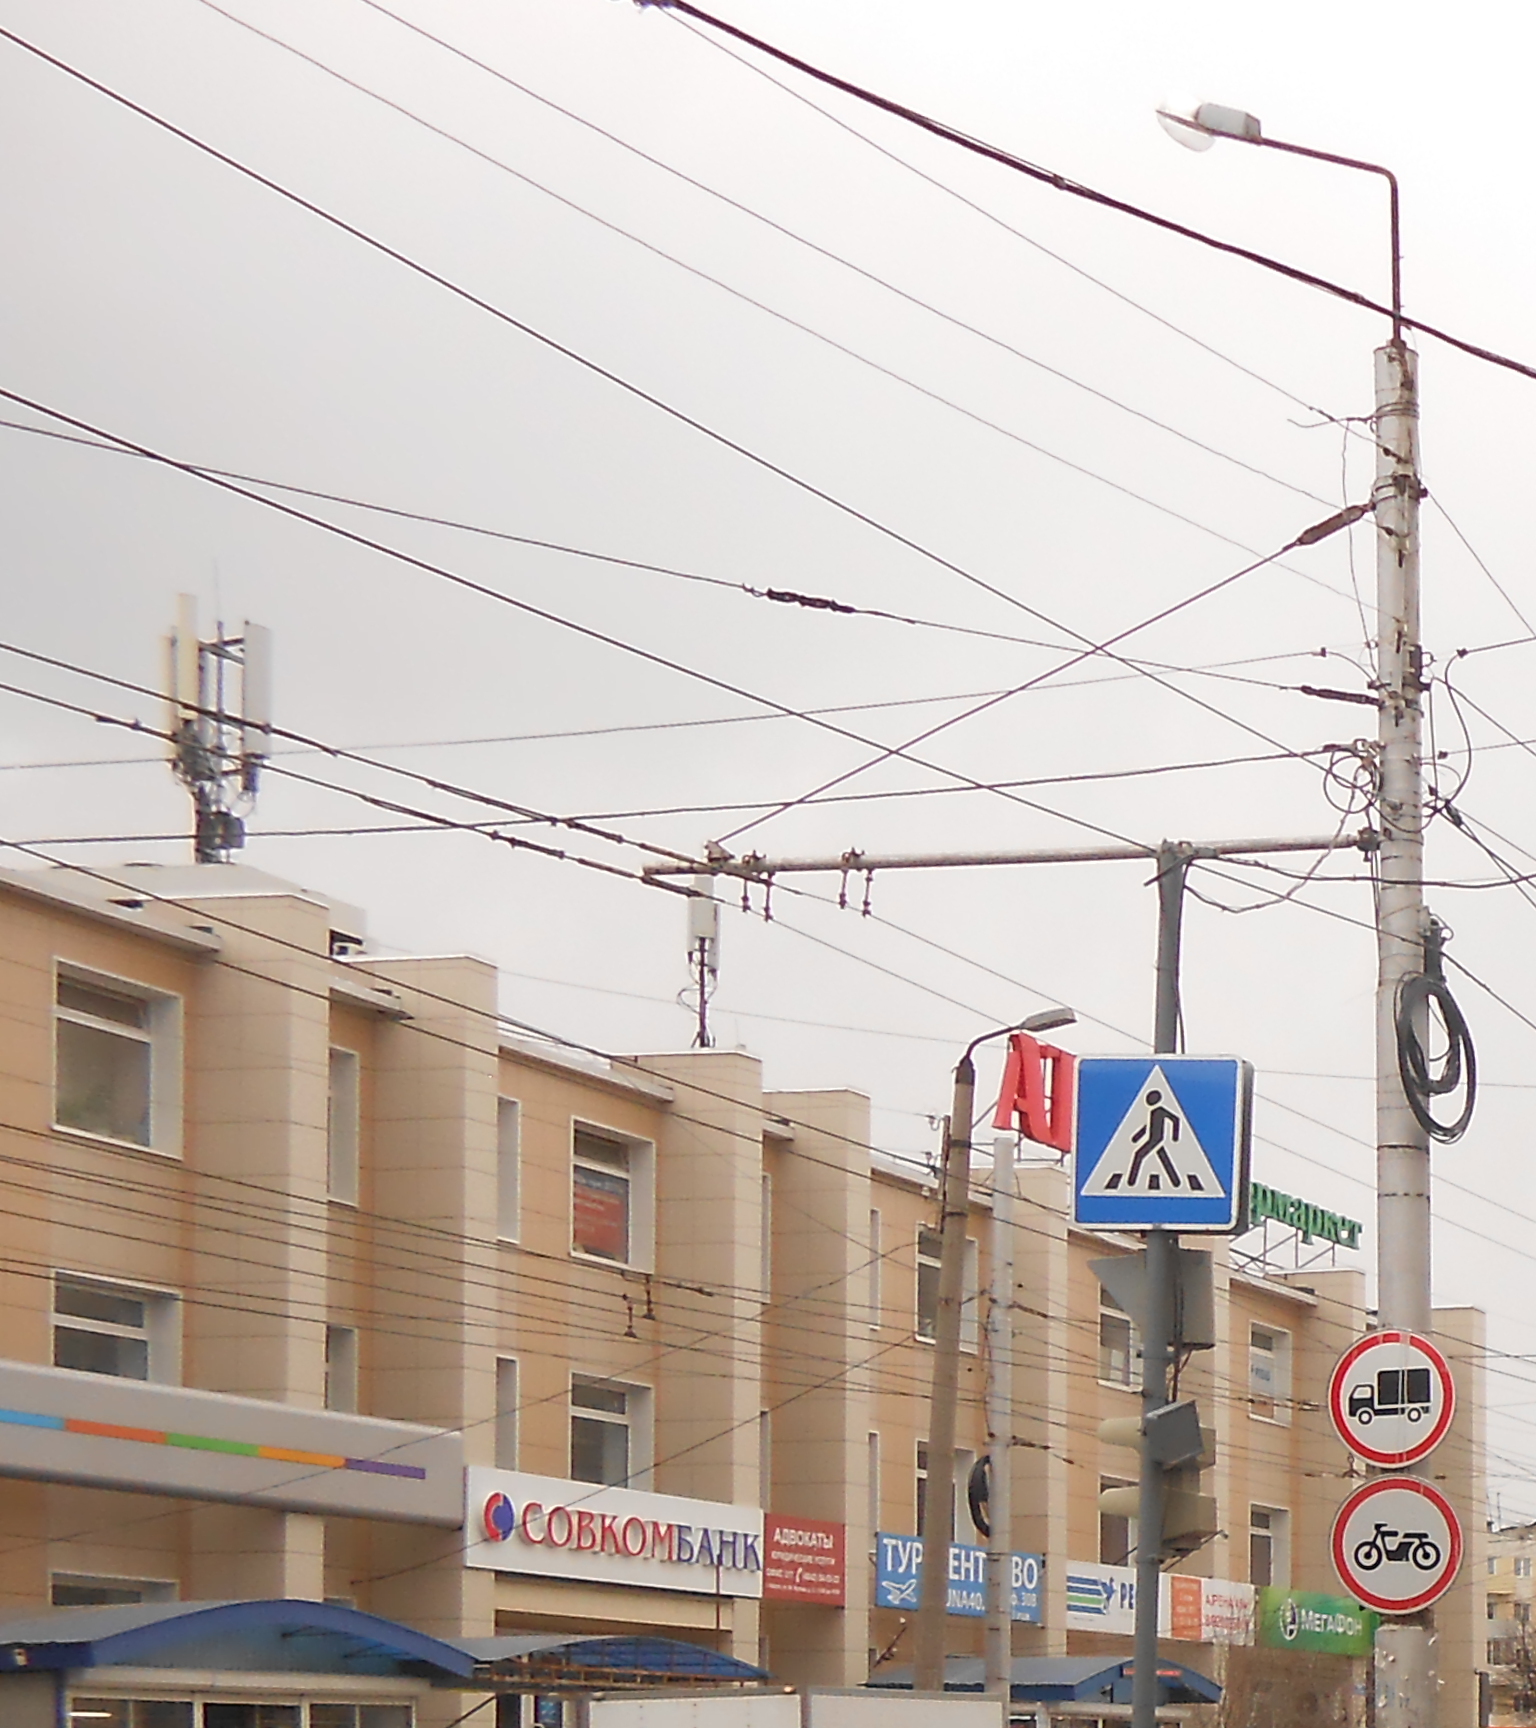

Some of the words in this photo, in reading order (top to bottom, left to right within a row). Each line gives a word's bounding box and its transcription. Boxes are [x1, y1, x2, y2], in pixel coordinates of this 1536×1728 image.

[1251, 1182, 1362, 1250] рмаркет
[521, 1500, 762, 1572] СОВКОМБАНК
[773, 1527, 834, 1550] АДВОКАТЫ
